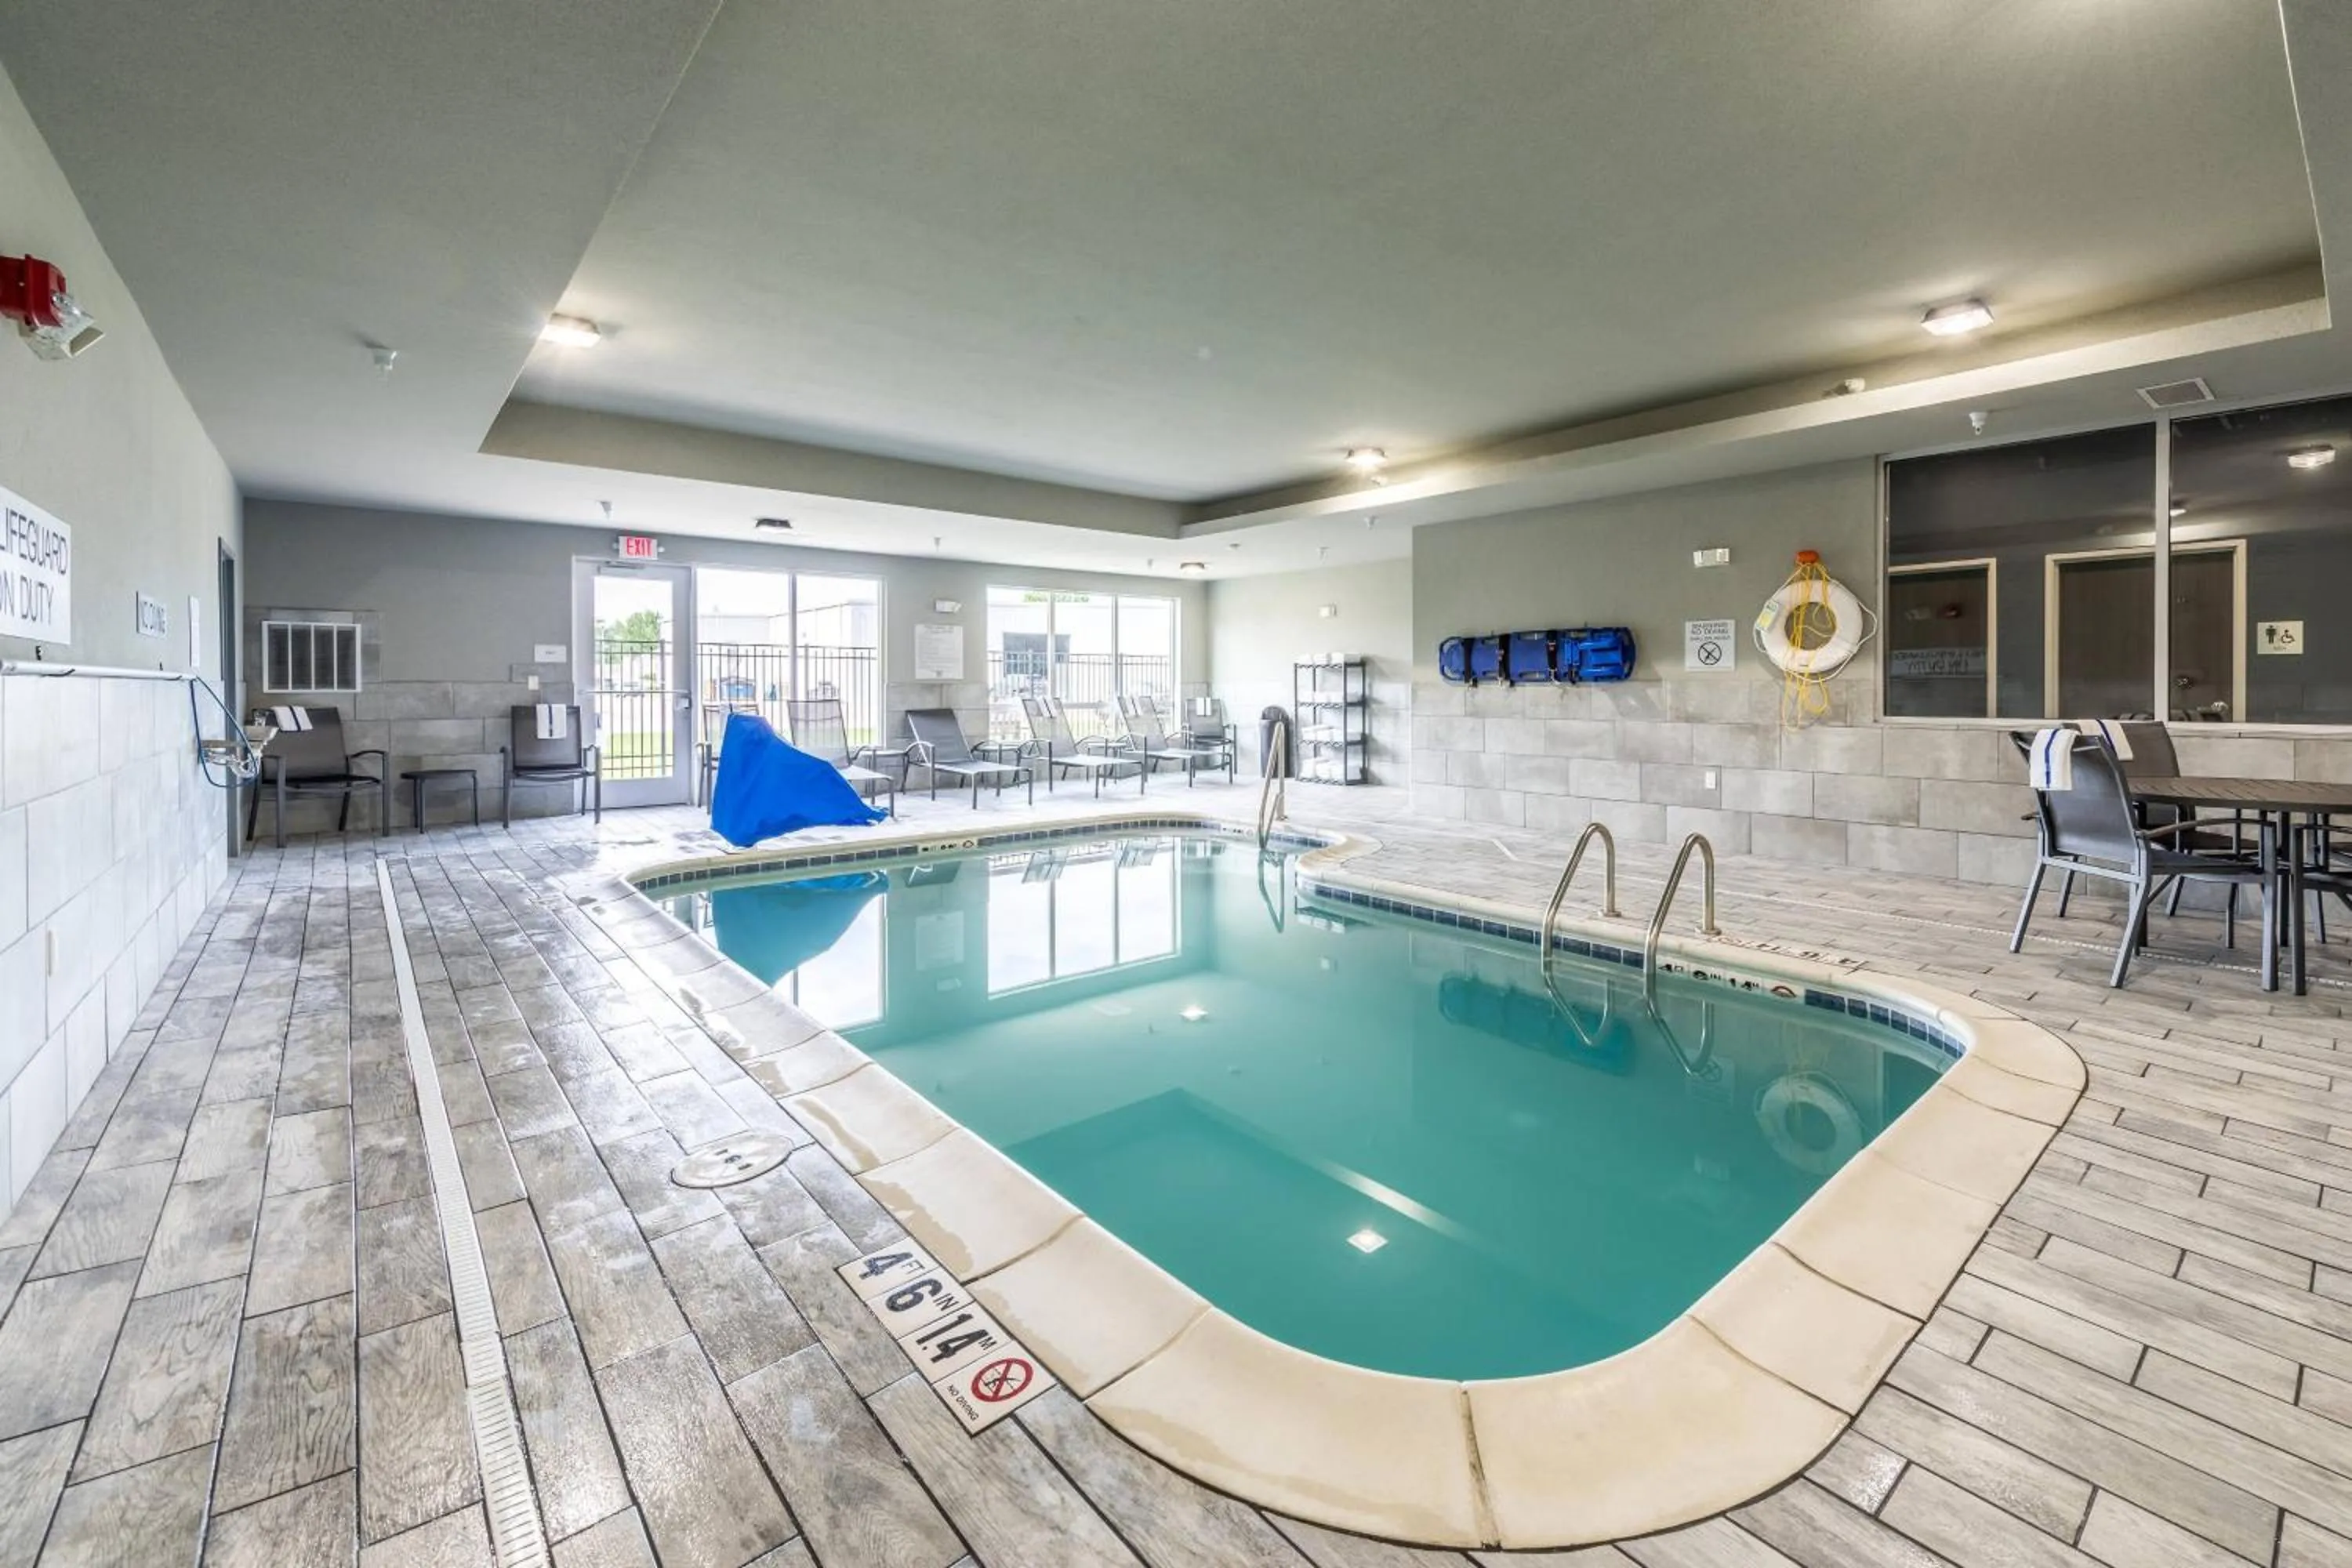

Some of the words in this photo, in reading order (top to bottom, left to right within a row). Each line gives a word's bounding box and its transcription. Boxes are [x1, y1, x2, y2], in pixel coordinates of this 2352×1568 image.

[626, 538, 652, 556] EXIT
[0, 570, 15, 616] N
[20, 575, 54, 626] DUTY
[858, 1252, 913, 1280] 4
[884, 1277, 942, 1312] 6
[932, 1293, 960, 1312] IN
[947, 1385, 960, 1396] NO
[956, 1396, 979, 1421] DIVING
